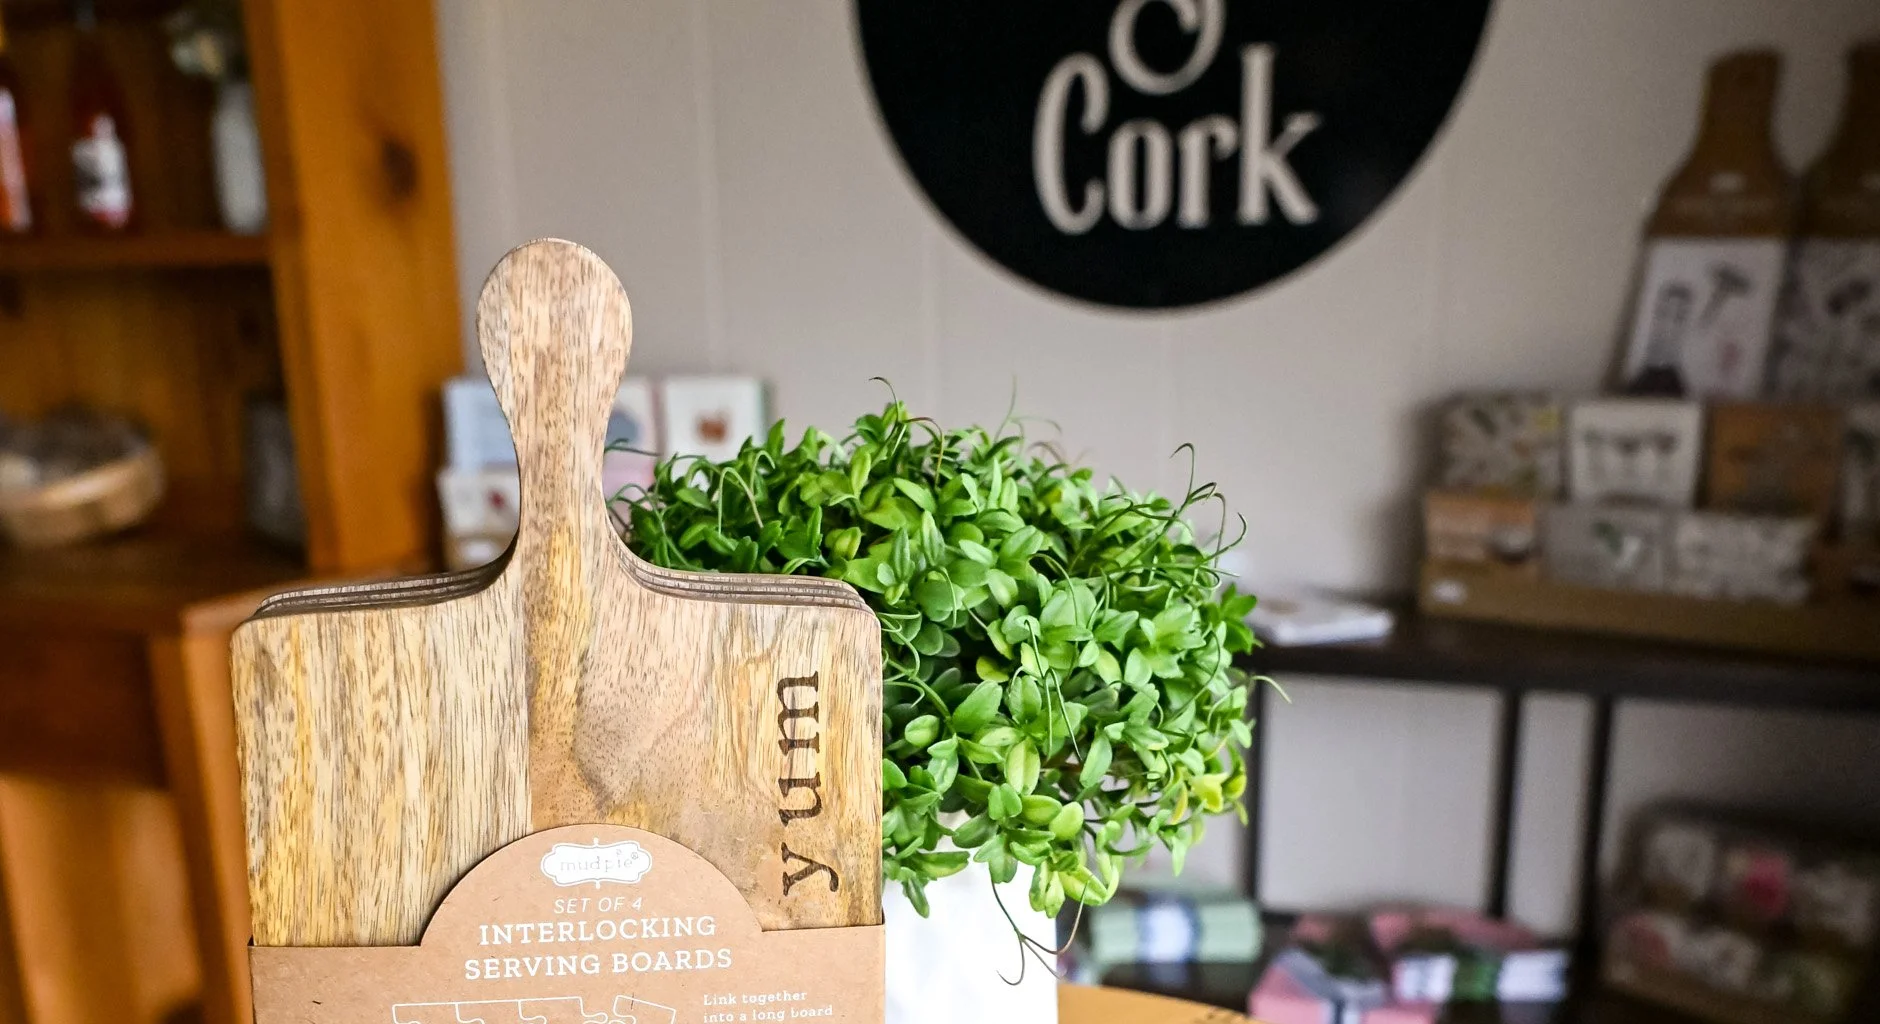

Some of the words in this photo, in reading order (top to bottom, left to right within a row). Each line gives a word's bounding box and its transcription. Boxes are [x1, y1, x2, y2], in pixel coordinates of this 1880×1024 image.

[1032, 42, 1322, 235] Cork
[777, 670, 839, 897] yum
[554, 897, 591, 914] SET
[598, 896, 625, 912] OF
[632, 896, 643, 912] 4
[479, 915, 716, 946] INTERLOCKING
[464, 954, 600, 980] SERVING
[612, 948, 732, 973] BOARDS
[703, 993, 737, 1006] Link
[742, 990, 807, 1005] together
[703, 1011, 734, 1024] into
[739, 1014, 747, 1022] a
[752, 1009, 785, 1022] long
[790, 1004, 833, 1019] board
